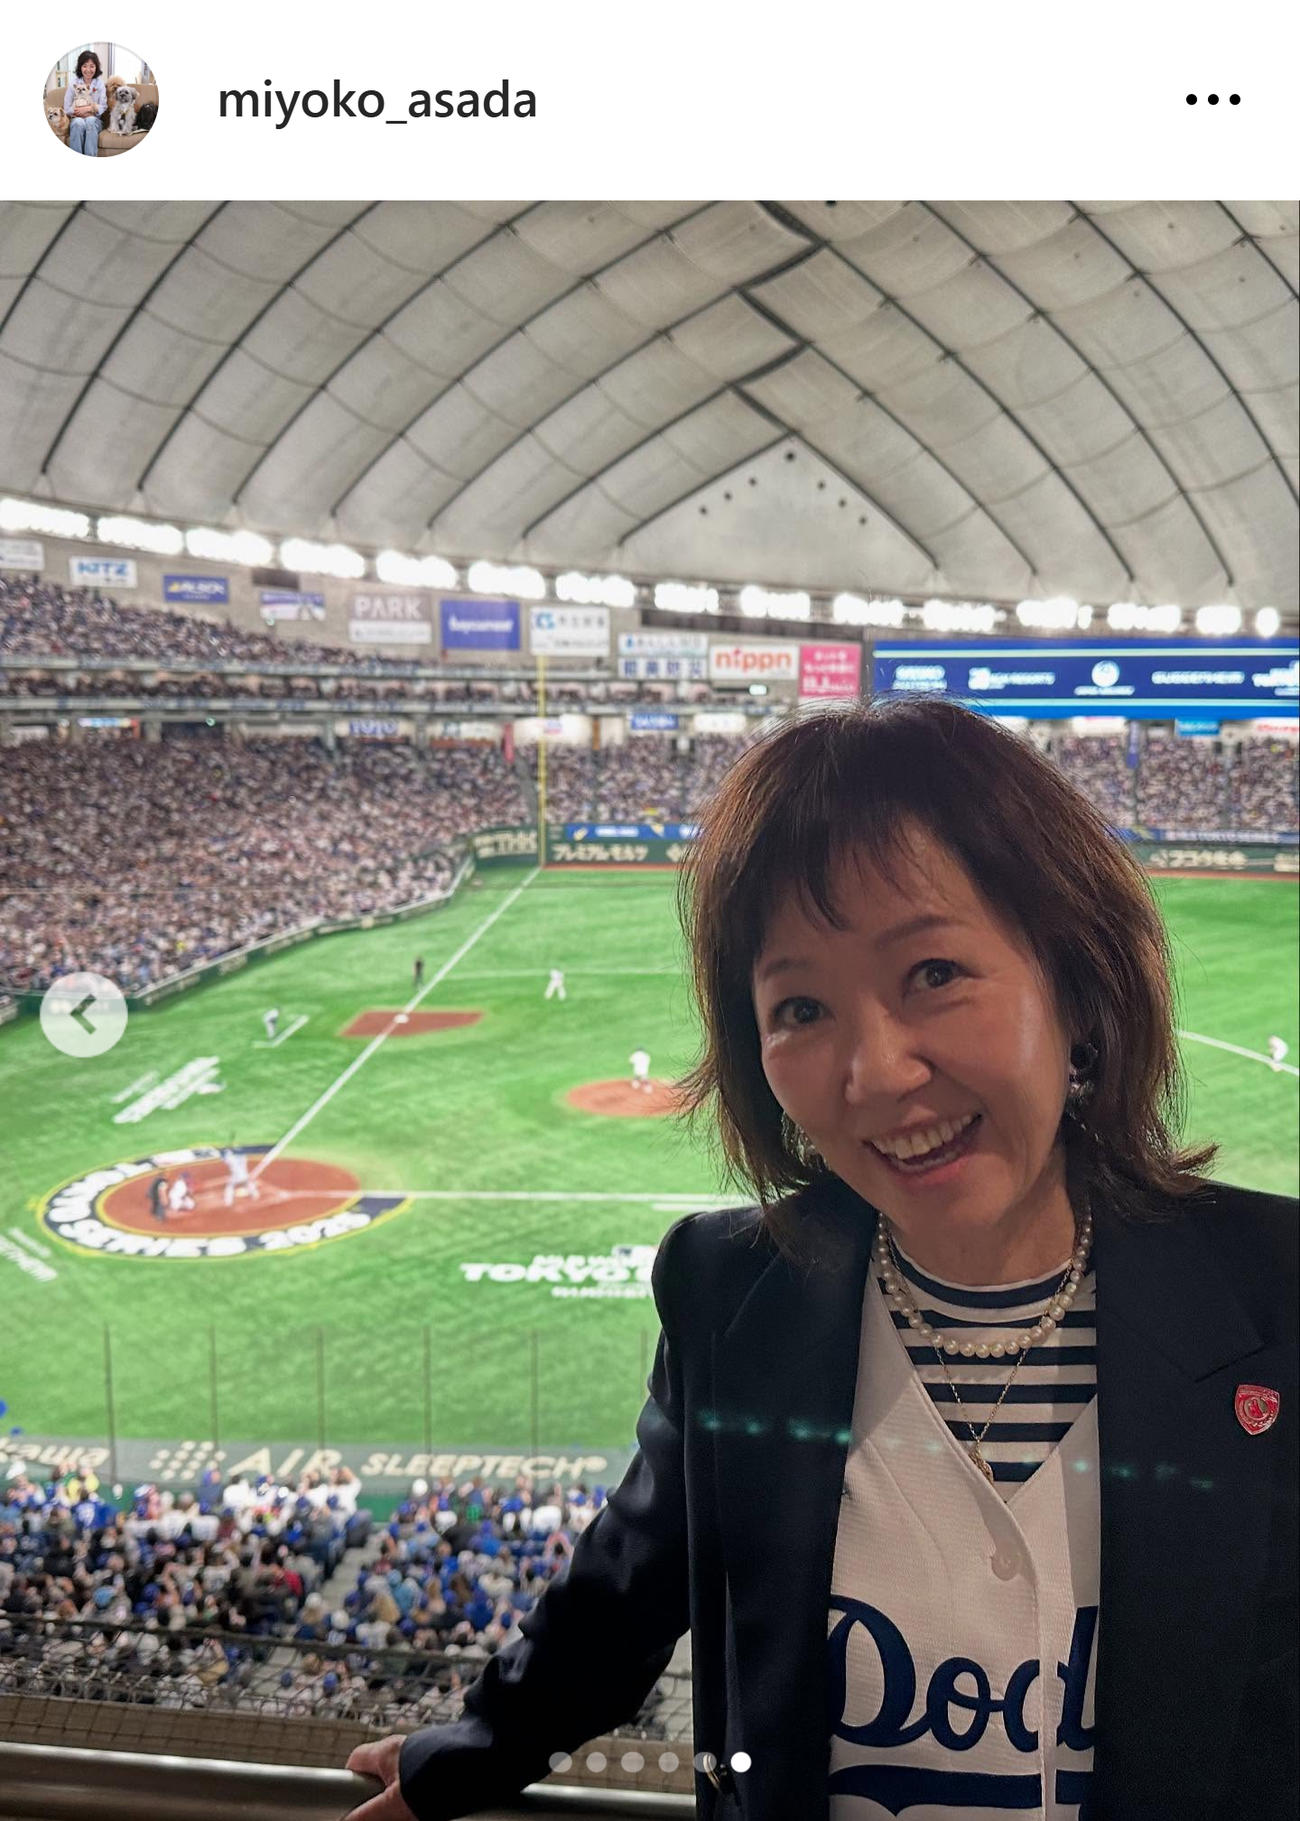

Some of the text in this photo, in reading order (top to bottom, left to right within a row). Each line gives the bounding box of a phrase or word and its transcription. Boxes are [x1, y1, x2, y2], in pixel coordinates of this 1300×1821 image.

[354, 594, 423, 619] PARK
[715, 647, 792, 673] nippn
[459, 1262, 632, 1283] TOKYO
[226, 1447, 344, 1480] AIR
